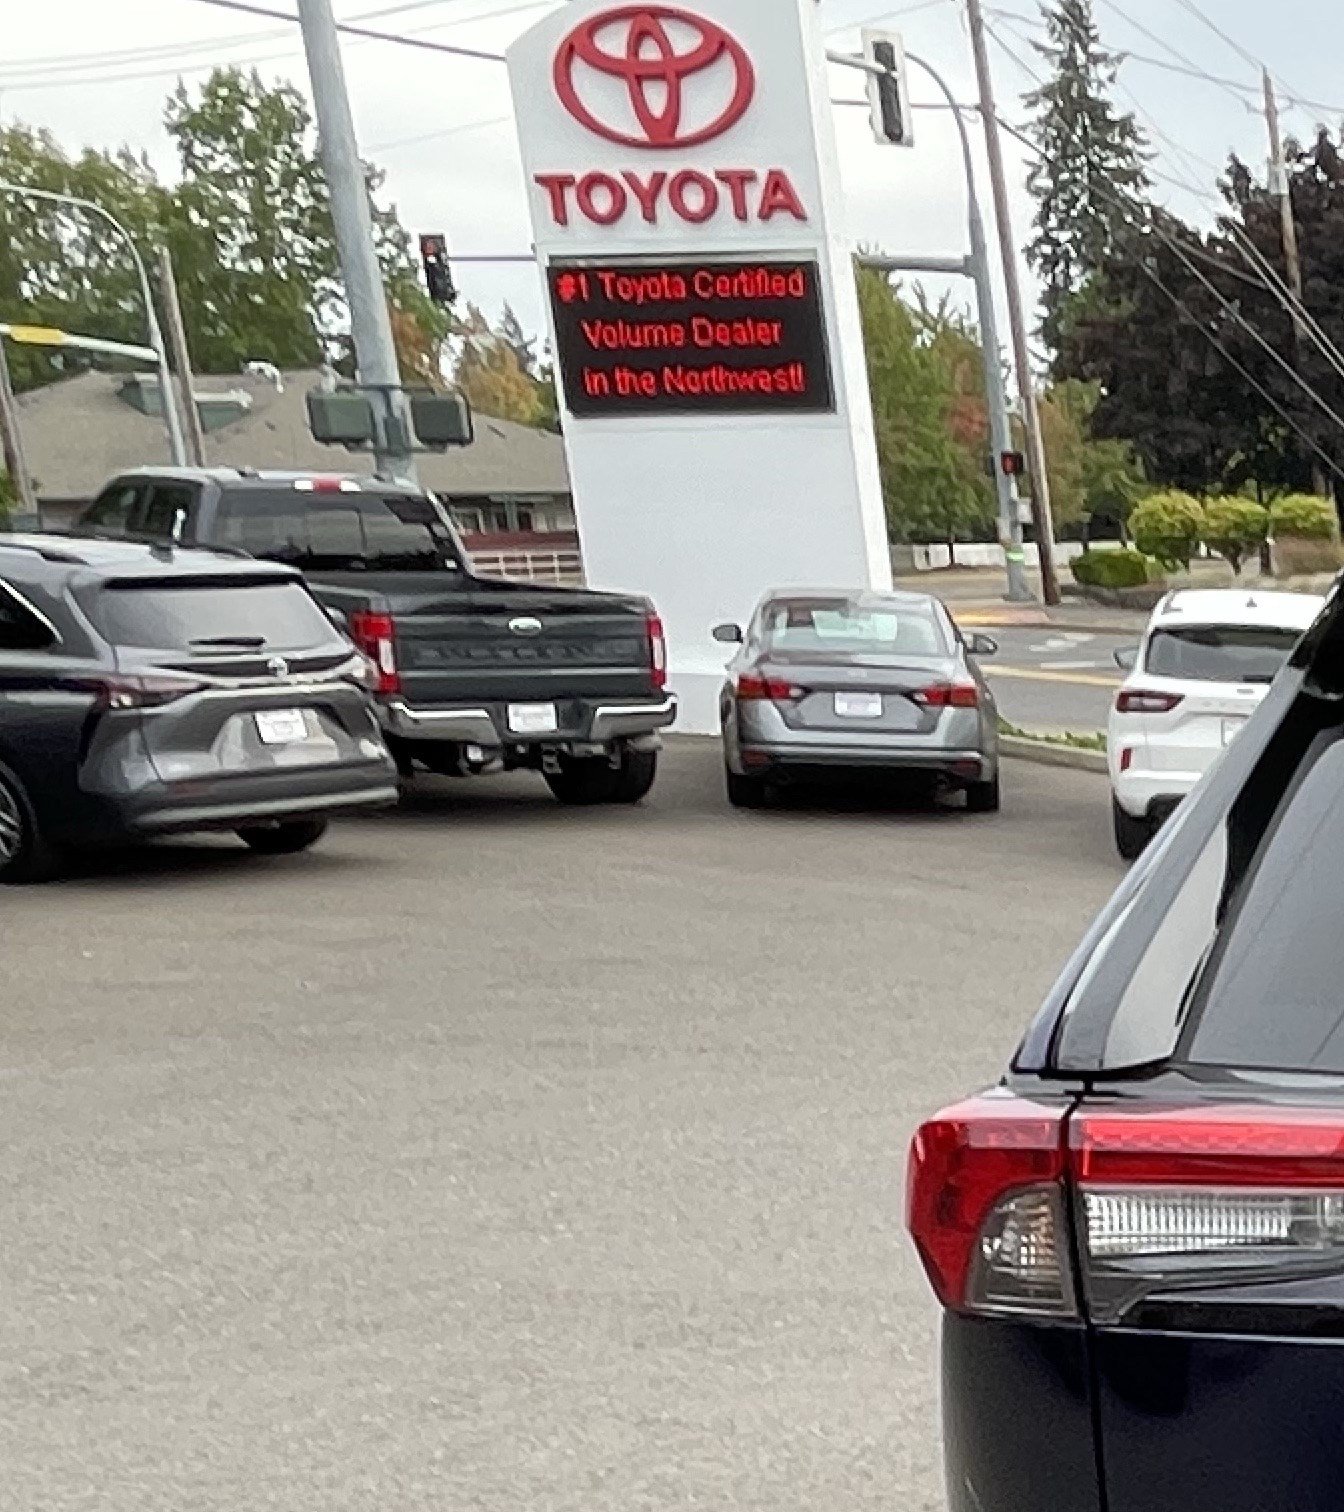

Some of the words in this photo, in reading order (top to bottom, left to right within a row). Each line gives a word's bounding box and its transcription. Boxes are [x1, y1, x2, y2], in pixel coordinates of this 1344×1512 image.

[534, 168, 807, 226] TOYOTA
[556, 273, 589, 303] #1
[597, 272, 685, 305] Toyota
[694, 266, 805, 298] Certified
[582, 318, 685, 349] Volume
[692, 315, 782, 347] Dealer
[614, 365, 657, 396] the
[663, 362, 806, 396] Northwest!
